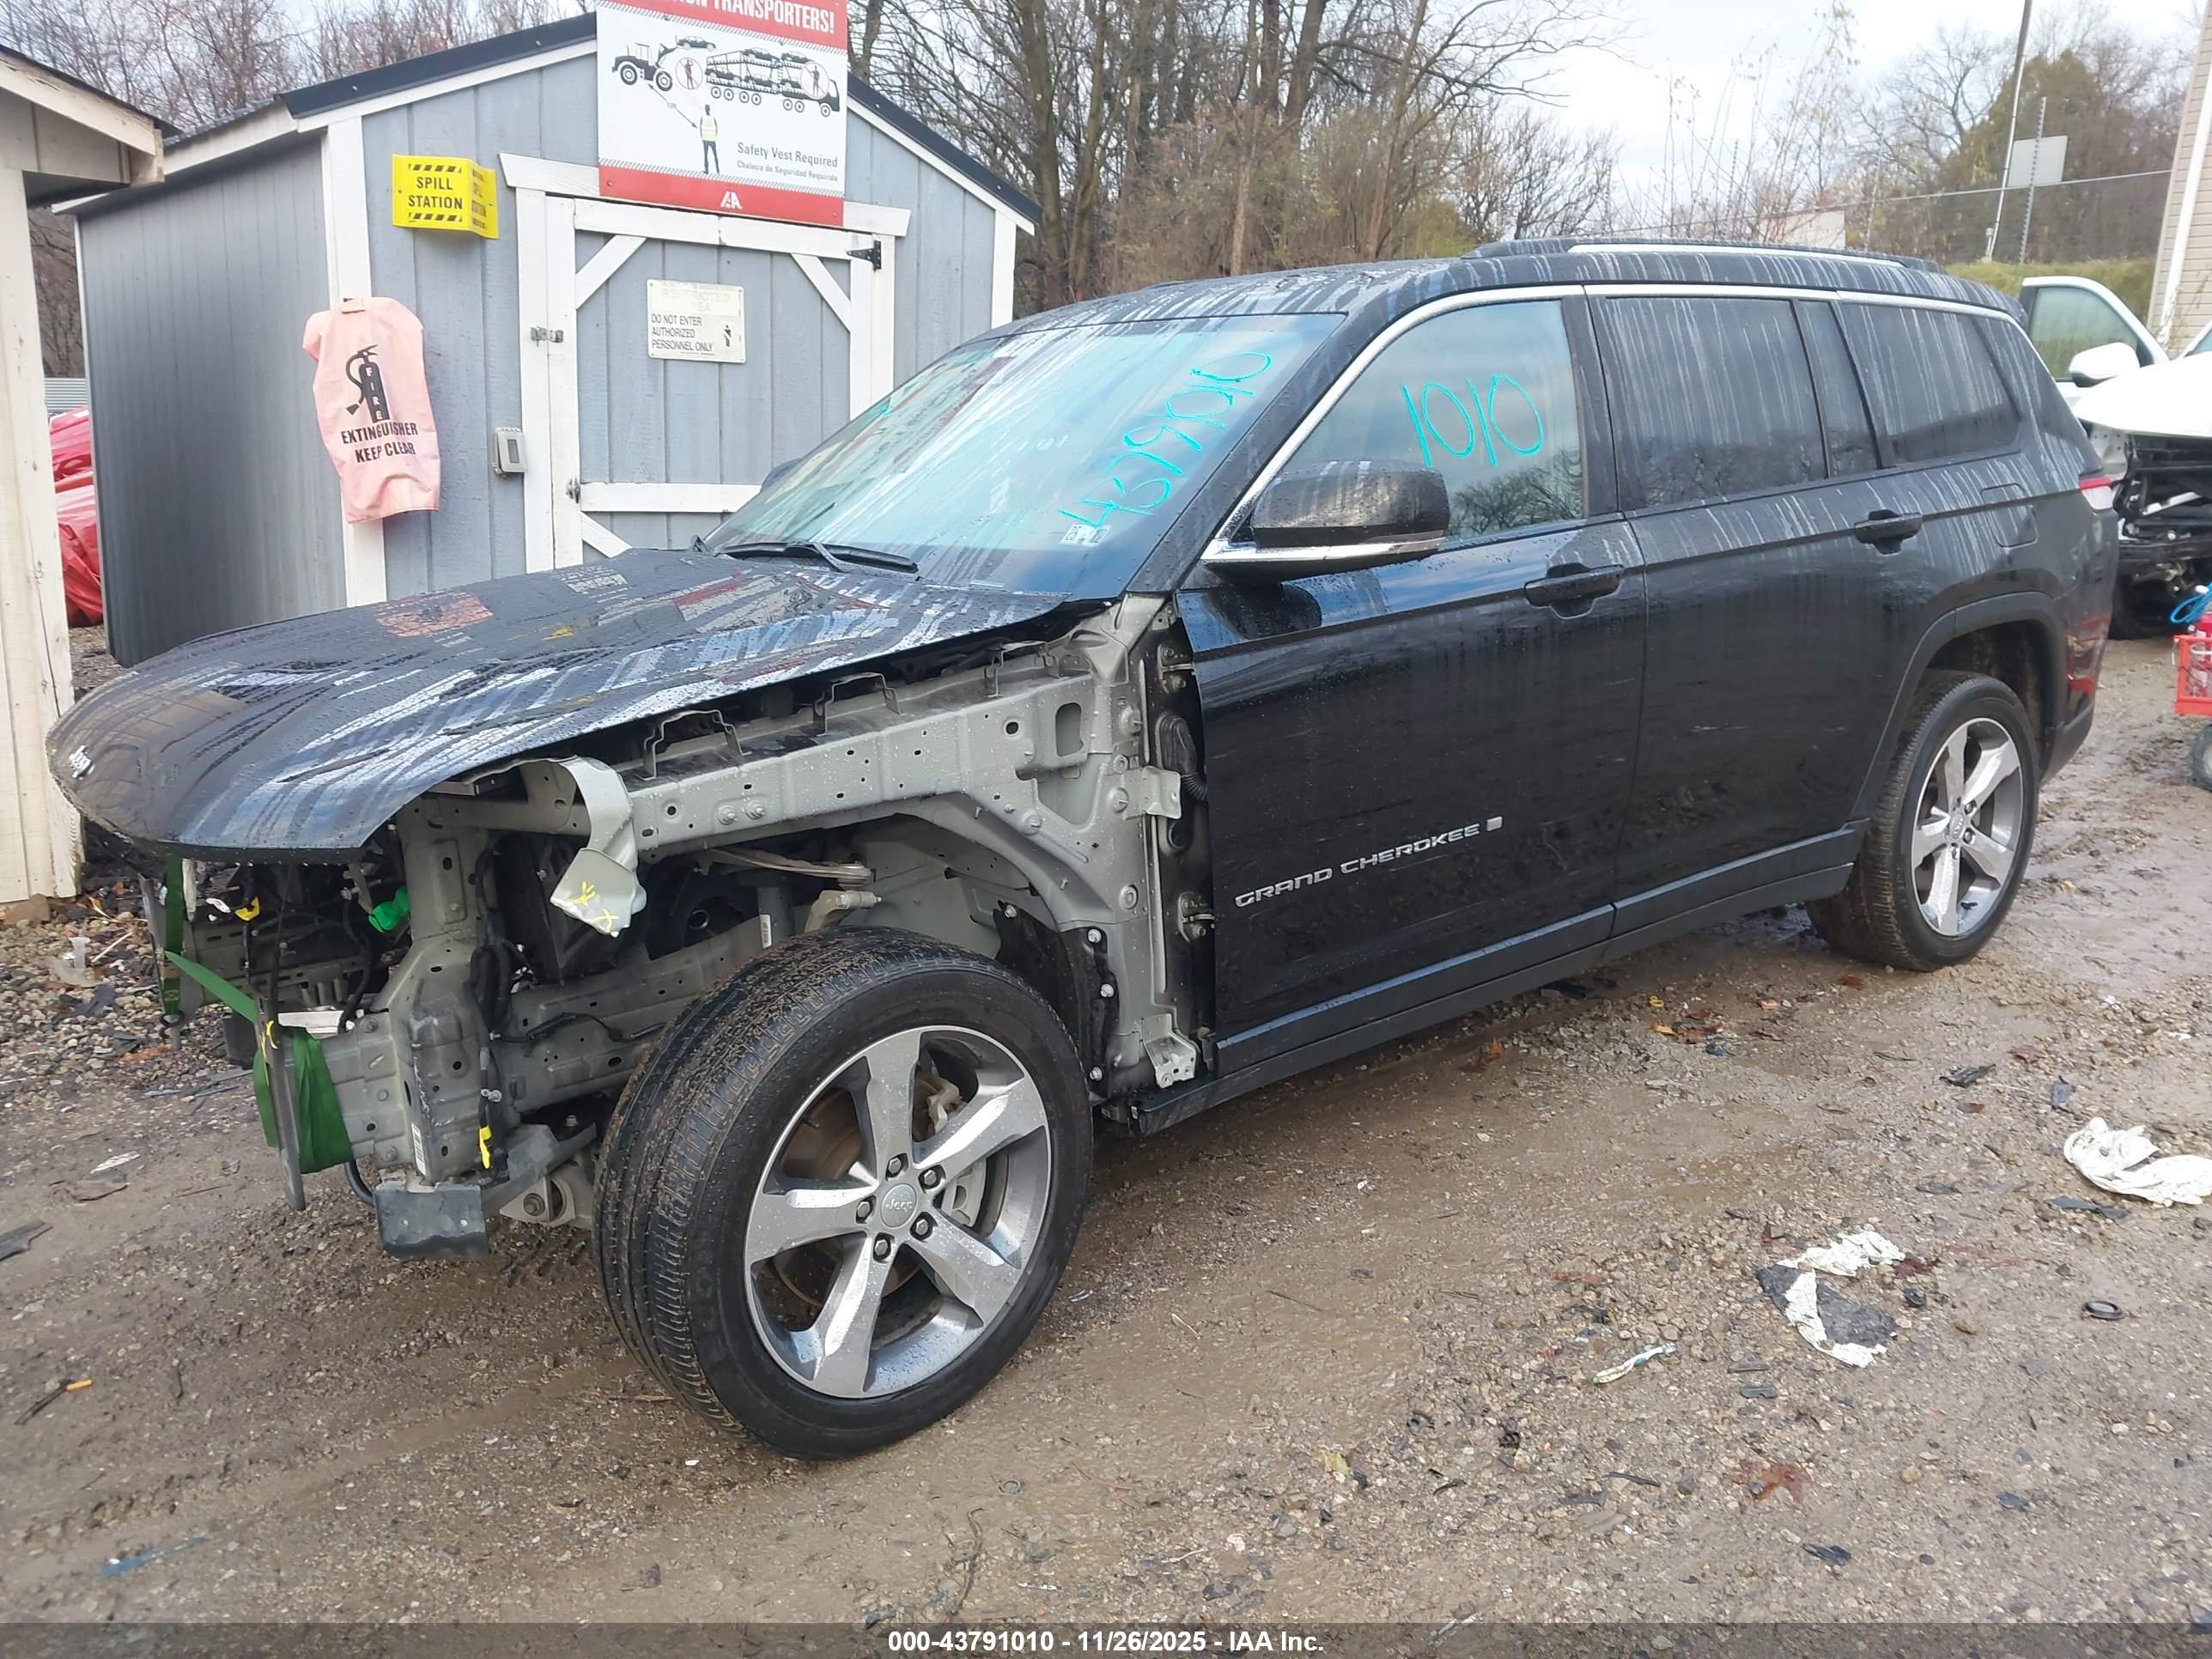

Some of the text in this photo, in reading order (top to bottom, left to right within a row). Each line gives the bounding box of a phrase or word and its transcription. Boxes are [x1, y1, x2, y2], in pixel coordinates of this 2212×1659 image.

[737, 142, 838, 167] Safety Vest Required
[416, 176, 454, 191] SPILL
[408, 194, 463, 210] STATION
[651, 313, 702, 327] DO NOT ENTER
[652, 326, 696, 338] AUTHORIZED
[652, 339, 714, 352] PERSONNEL ONLY
[366, 368, 384, 420] FIRE
[1401, 373, 1544, 467] 1010
[341, 422, 419, 444] EXTINGUISHER
[357, 442, 416, 463] KEEP CLEAR
[1235, 823, 1480, 908] GRAND CHEROKEE
[885, 1198, 913, 1212] Jeep
